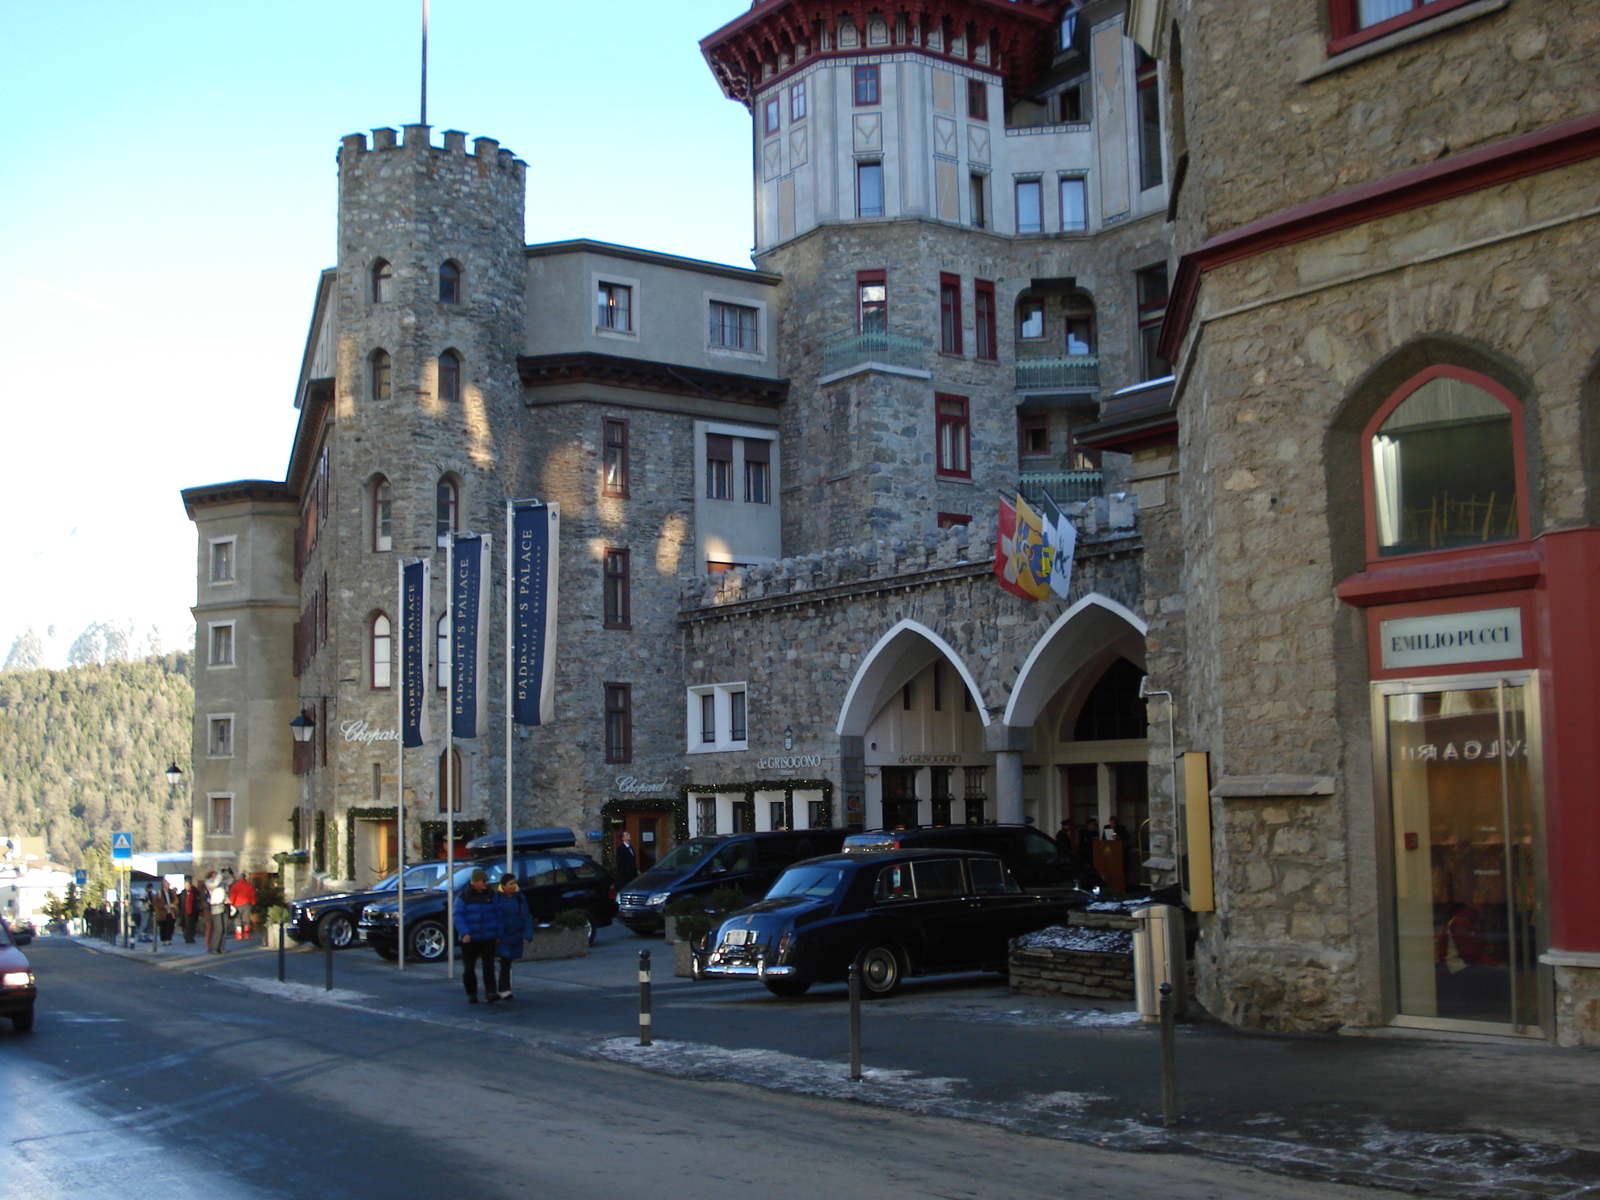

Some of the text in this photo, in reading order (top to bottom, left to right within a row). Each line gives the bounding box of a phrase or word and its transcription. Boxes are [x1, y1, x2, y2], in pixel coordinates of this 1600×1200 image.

[520, 529, 532, 595] PALACE
[456, 559, 469, 714] BADRUTT'S PALACE
[1391, 626, 1510, 652] EMILIO PUCCI
[757, 754, 822, 770] de GRISOGONO
[898, 754, 962, 764] de GRISOGONO
[615, 775, 668, 796] Chopard
